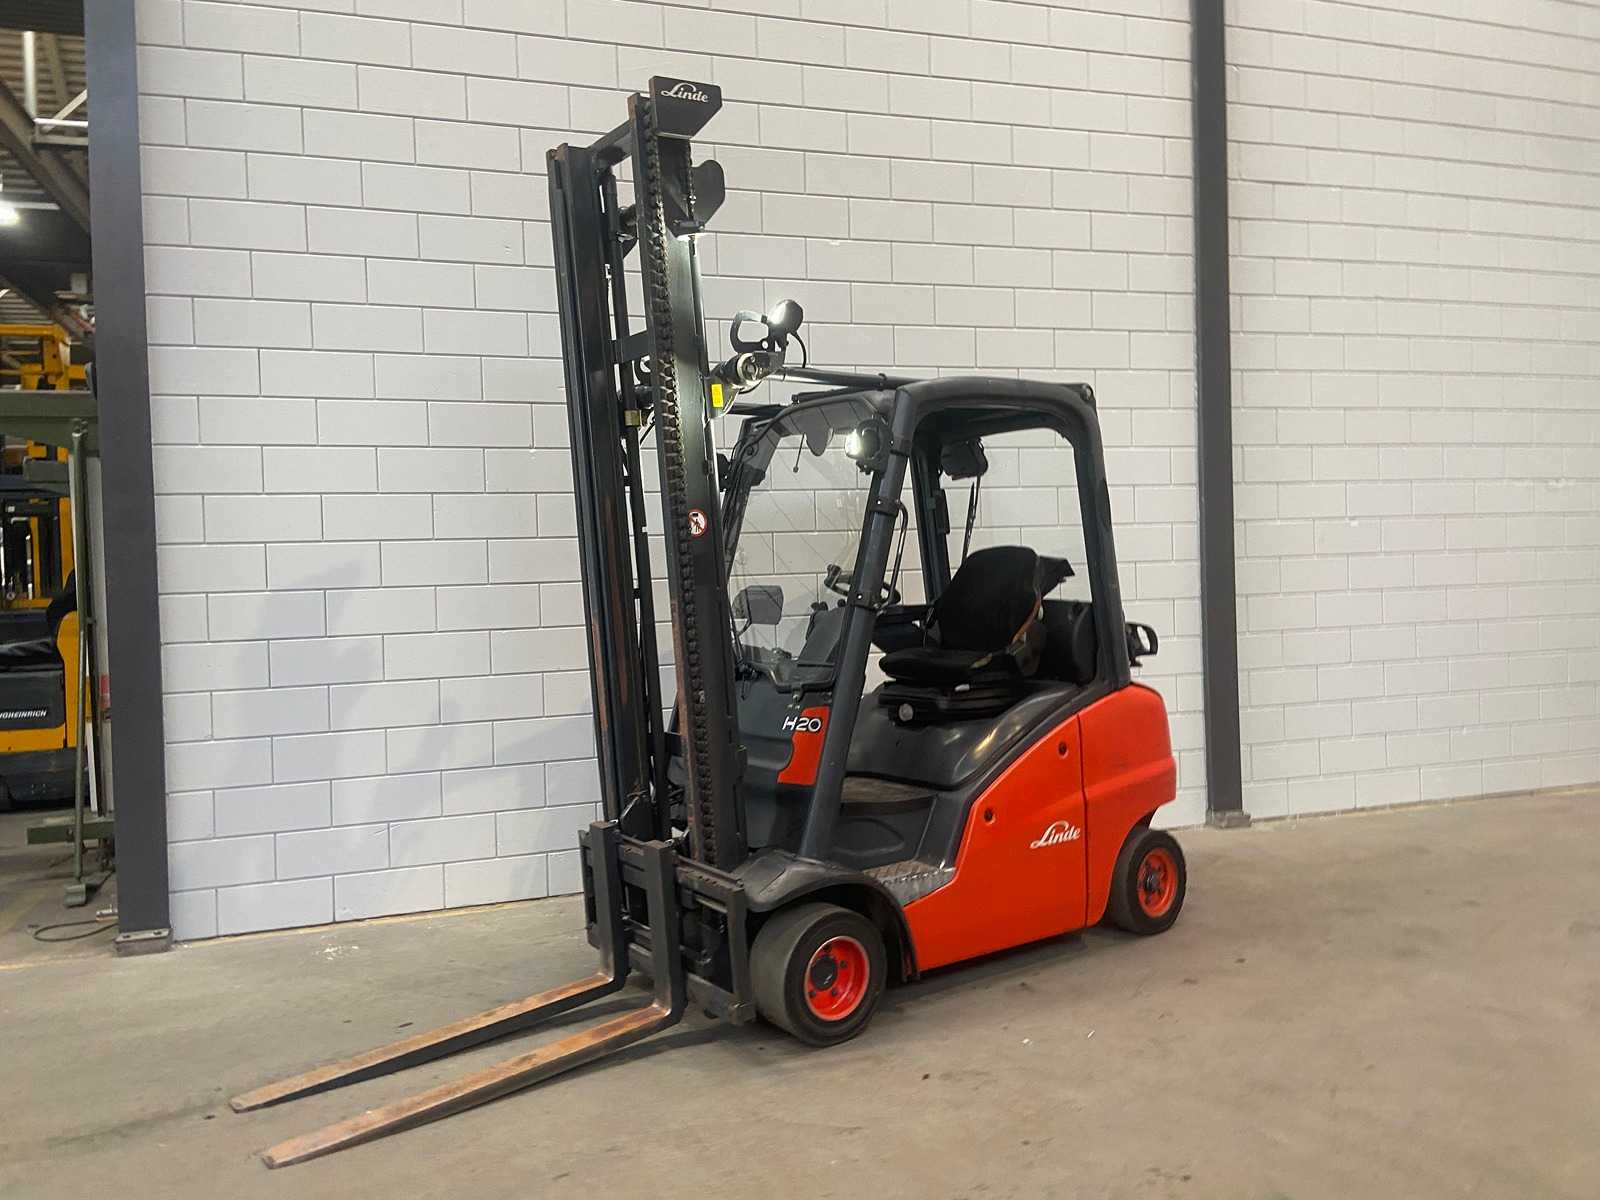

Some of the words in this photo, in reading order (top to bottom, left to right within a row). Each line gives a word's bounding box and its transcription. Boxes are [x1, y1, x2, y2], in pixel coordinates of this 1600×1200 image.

[661, 82, 709, 103] Linde
[782, 716, 821, 732] H20
[1030, 820, 1081, 849] Linde
